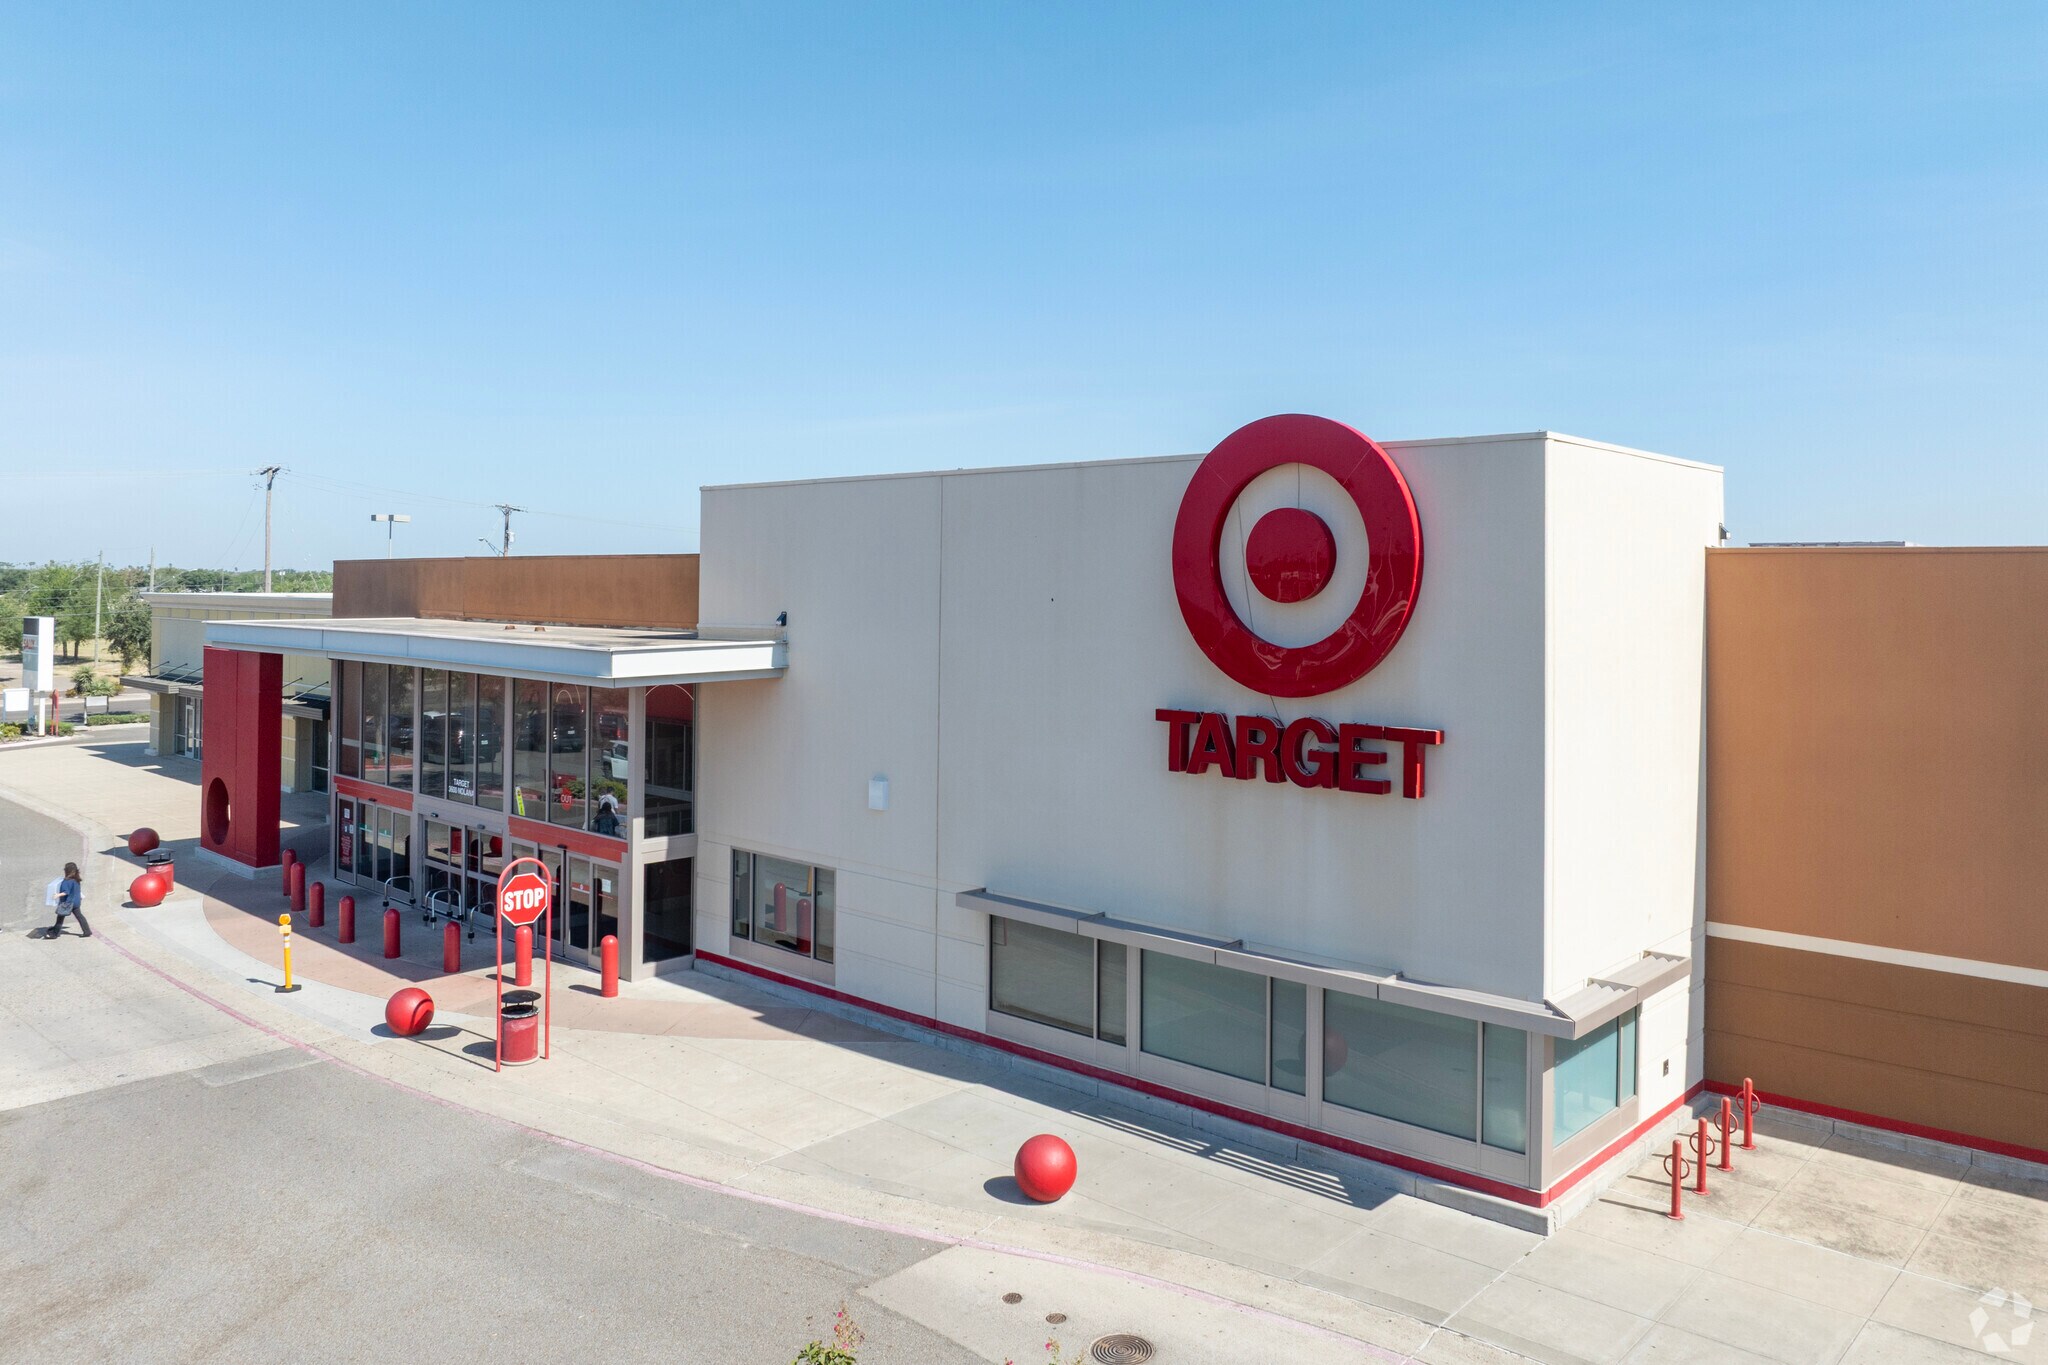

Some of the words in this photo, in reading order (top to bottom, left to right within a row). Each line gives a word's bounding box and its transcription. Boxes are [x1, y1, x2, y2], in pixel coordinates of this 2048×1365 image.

[1155, 708, 1445, 799] TARGET
[453, 778, 470, 788] TARGET
[561, 794, 572, 804] OUT
[504, 887, 544, 912] STOP
